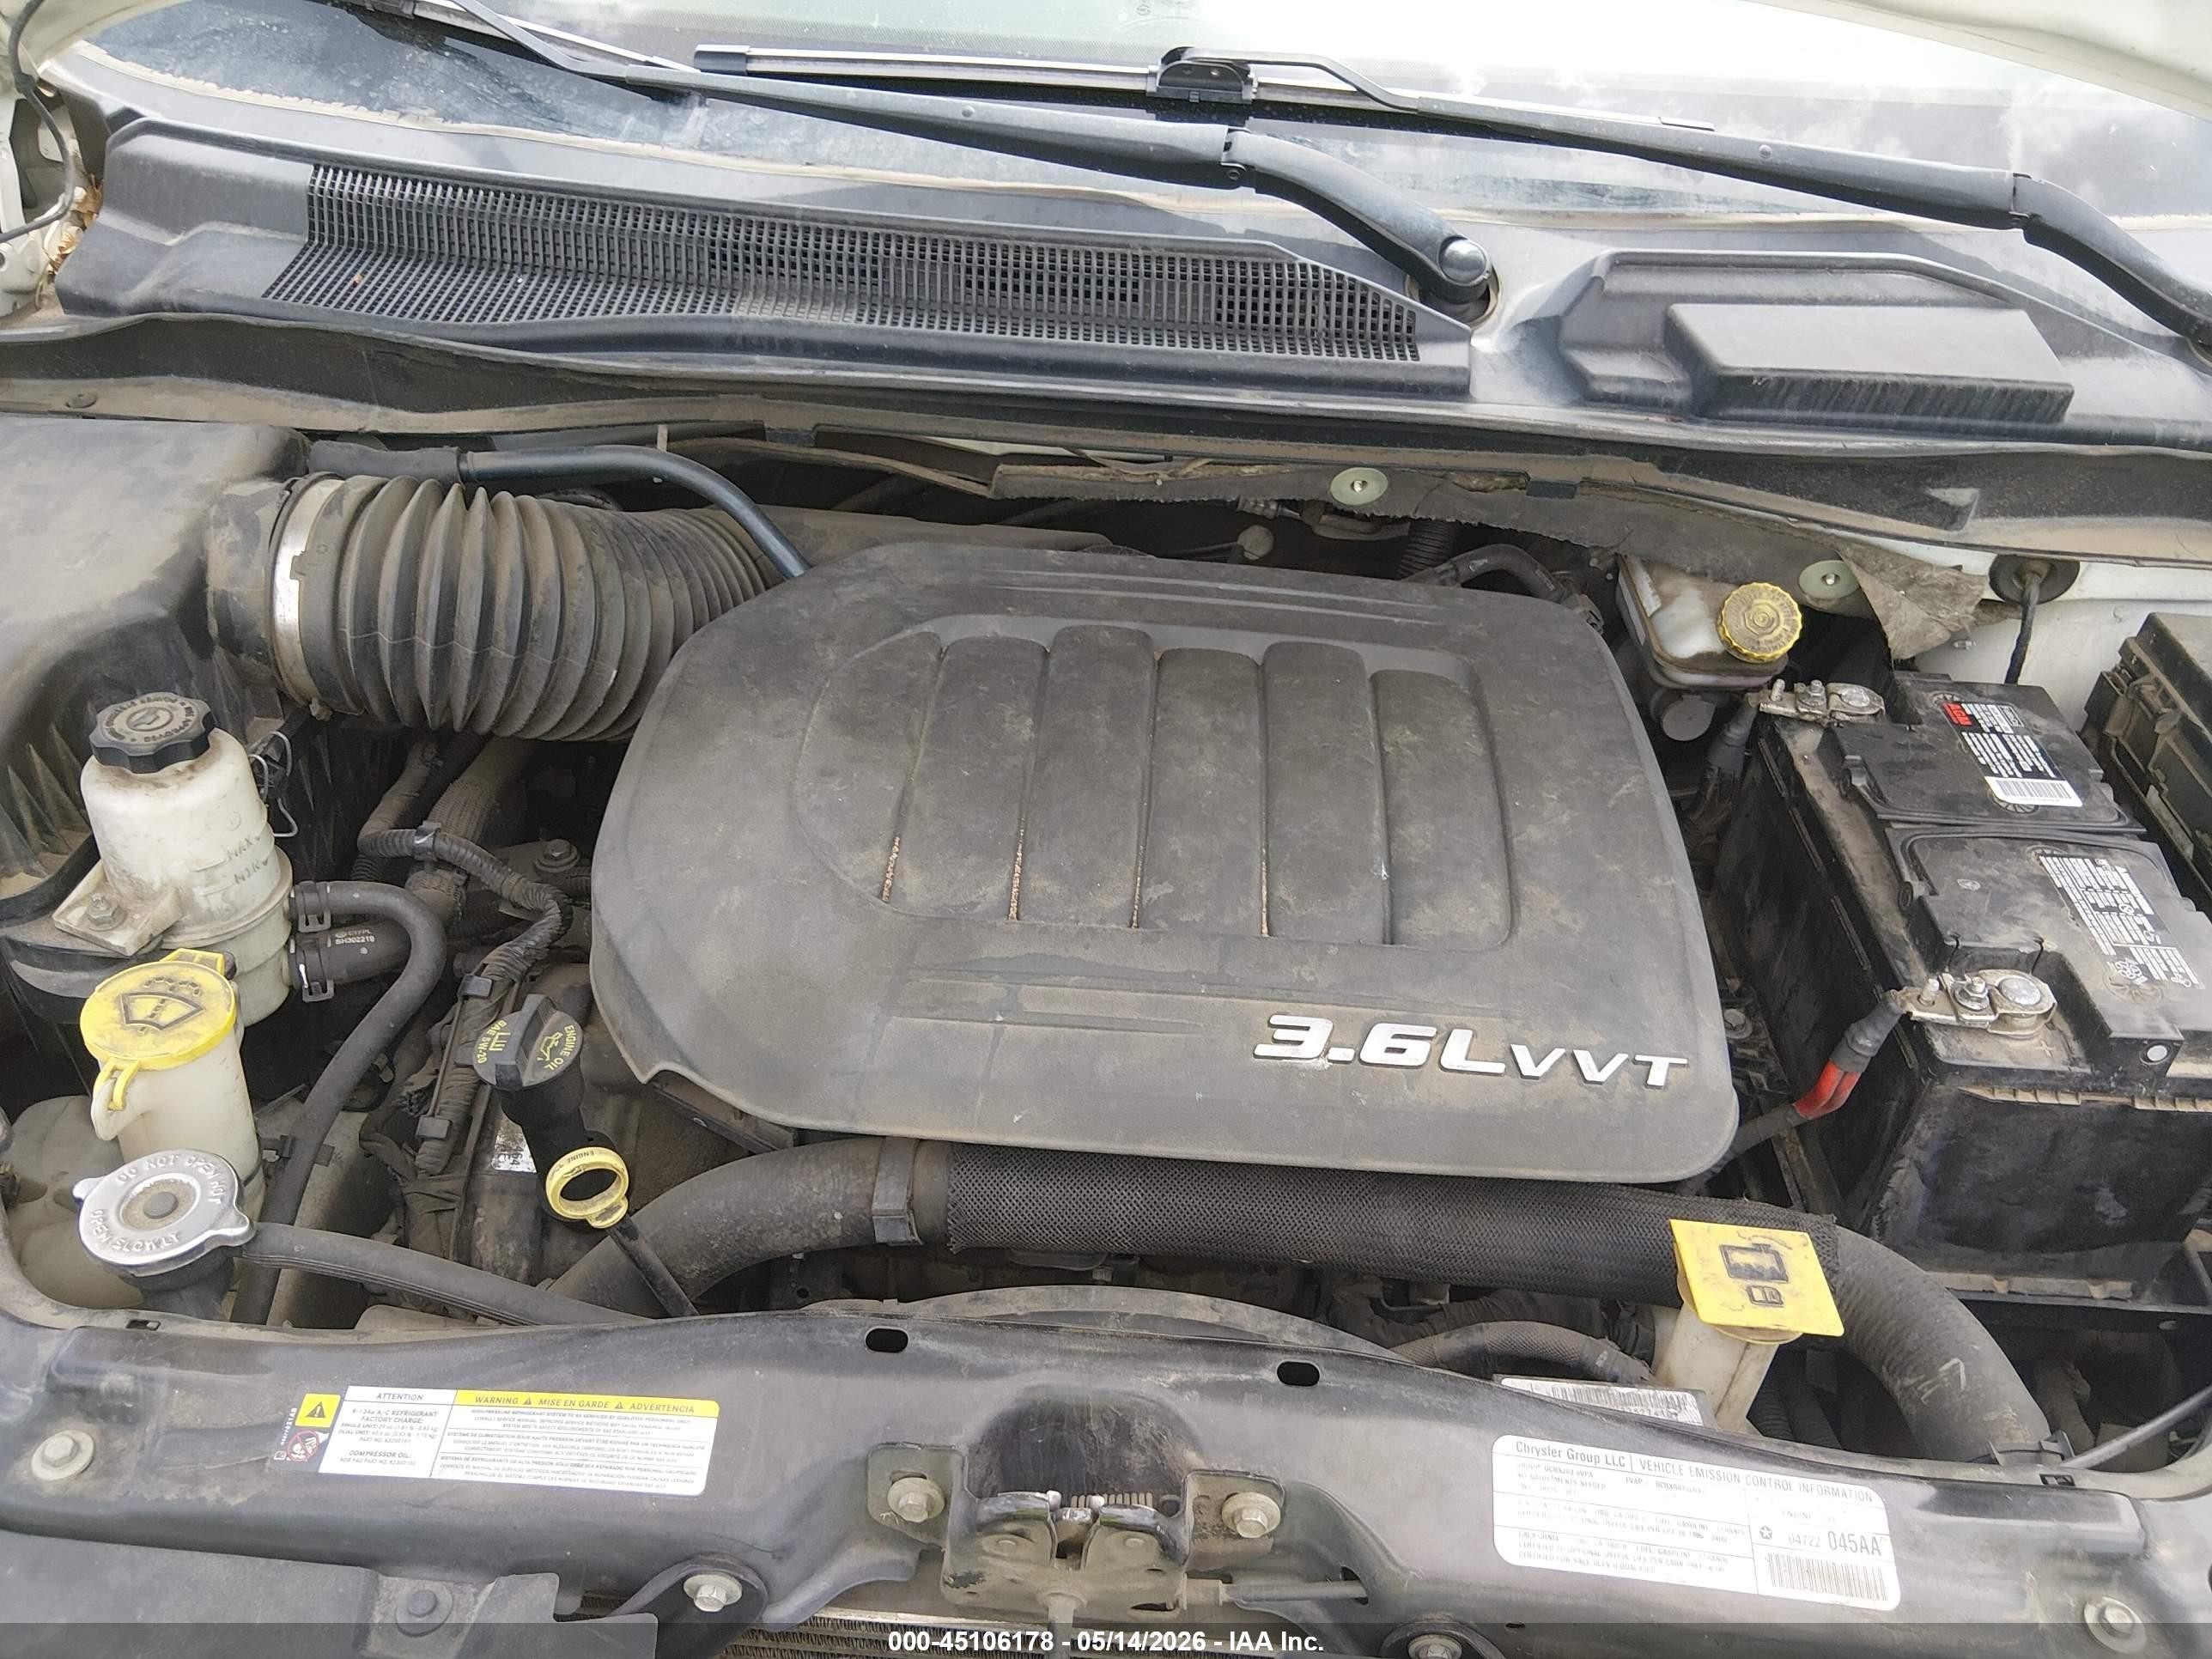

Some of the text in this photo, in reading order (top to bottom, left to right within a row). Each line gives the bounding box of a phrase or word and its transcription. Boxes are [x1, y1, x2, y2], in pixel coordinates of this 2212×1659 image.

[477, 1036, 490, 1064] 5W-20
[544, 1024, 577, 1071] ENGINE OIL
[116, 1155, 226, 1205] DO NOT OPEN HOT
[89, 1208, 180, 1252] OPEN SLOWLY
[474, 1396, 519, 1405] WARNING
[629, 1403, 695, 1413] ADVERTENCIA
[1516, 1441, 1626, 1468] Chrysler Group LLC
[1639, 1459, 1873, 1503] VEHICLE EMISSION CONTROL INFORMATION
[1827, 1530, 1881, 1556] 045AA
